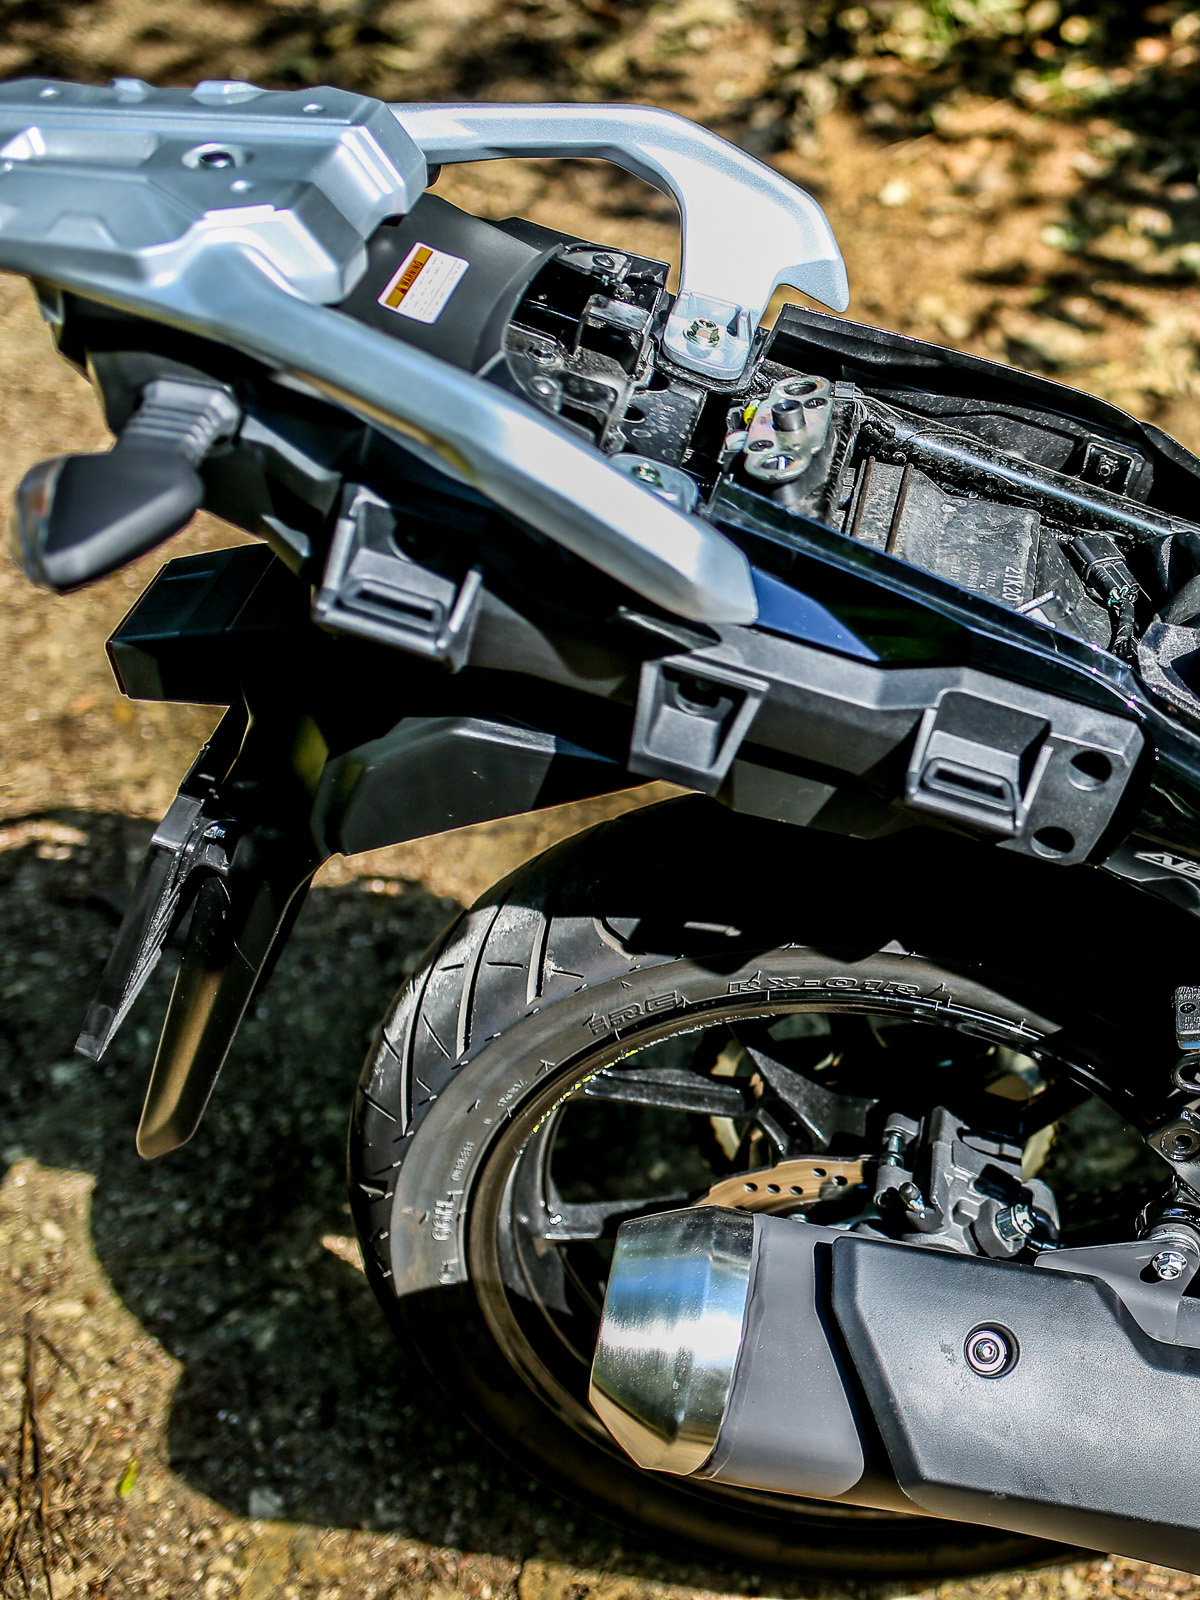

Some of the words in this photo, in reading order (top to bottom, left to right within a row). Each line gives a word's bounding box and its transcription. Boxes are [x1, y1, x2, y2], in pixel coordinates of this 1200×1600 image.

[400, 260, 424, 286] WARNING
[1002, 566, 1025, 601] 21K20
[727, 976, 920, 996] RX-01R
